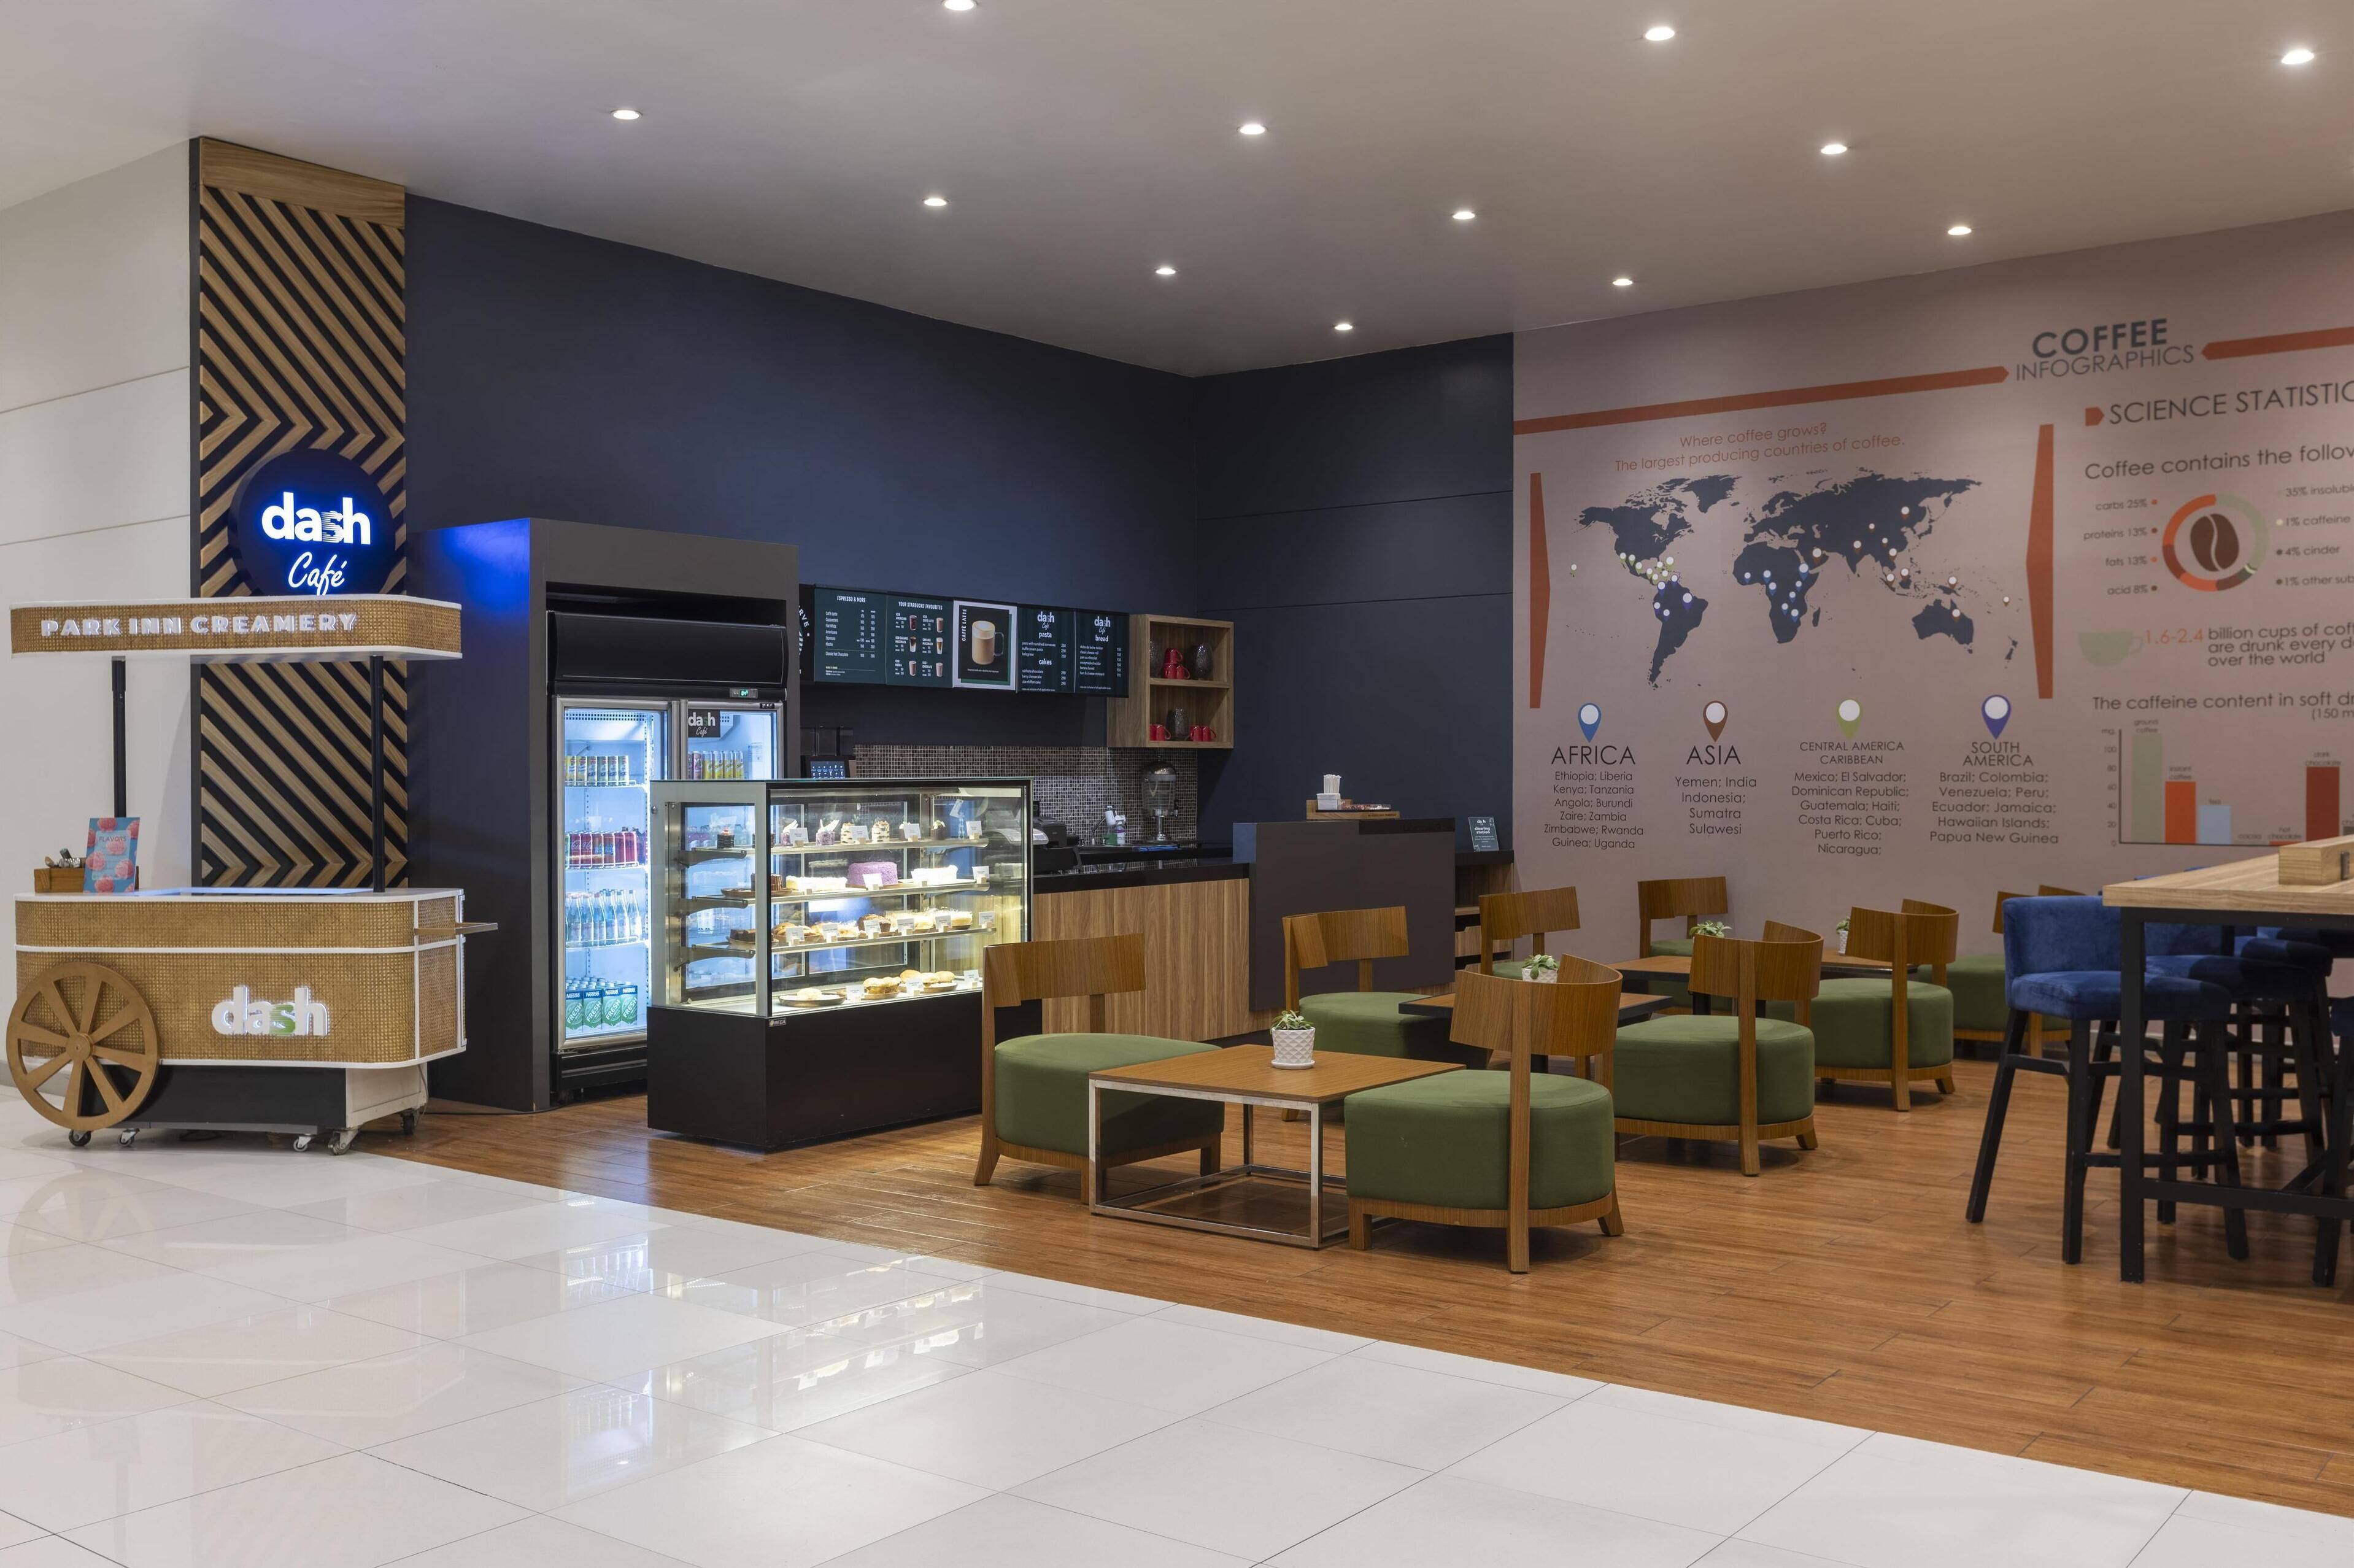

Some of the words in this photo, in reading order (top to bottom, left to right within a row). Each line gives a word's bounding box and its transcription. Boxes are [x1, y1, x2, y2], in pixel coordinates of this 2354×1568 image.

[2032, 319, 2168, 359] COFFEE
[2017, 343, 2194, 380] INFOGRAPHICS
[2110, 393, 2226, 424] SCIENCE
[1680, 435, 1723, 447] Where
[1727, 428, 1775, 442] coffee
[1777, 422, 1827, 441] grows?
[1615, 457, 1637, 471] The
[1640, 450, 1685, 470] largest
[1689, 446, 1760, 468] producing
[1764, 442, 1829, 457] countries
[1833, 438, 1847, 451] of
[1851, 434, 1904, 449] coffee.
[2085, 461, 2155, 479] Coffee
[2161, 452, 2250, 473] contains
[2257, 449, 2292, 465] the
[2285, 487, 2307, 497] 35%
[2310, 484, 2354, 495] insolubl
[2096, 501, 2124, 511] carbs
[2128, 498, 2148, 508] 25%
[261, 492, 371, 545] dash
[2286, 517, 2300, 526] 1%
[2302, 516, 2351, 525] caffeine
[2083, 528, 2124, 541] proteins
[2128, 527, 2148, 536] 13%
[2285, 547, 2301, 556] 4%
[2303, 546, 2340, 555] cinder
[2105, 558, 2124, 566] fats
[2128, 555, 2147, 565] 13%
[288, 552, 347, 595] Café
[2285, 577, 2299, 586] 1%
[2302, 576, 2333, 585] other
[2107, 585, 2131, 595] acid
[2133, 584, 2148, 594] 8%
[1037, 611, 1055, 623] dash
[1094, 616, 1111, 627] dash
[41, 618, 123, 636] PARK
[129, 616, 183, 635] INN
[190, 614, 357, 635] CREAMERY
[2209, 627, 2253, 640] billion
[2258, 627, 2297, 641] cups
[2302, 623, 2318, 636] of
[2323, 622, 2354, 636] cof
[2147, 628, 2204, 644] 1.6-2.4
[2208, 643, 2234, 654] are
[2239, 638, 2285, 652] drunk
[2290, 639, 2336, 652] every
[2208, 656, 2244, 666] over
[2249, 653, 2274, 665] the
[2279, 651, 2325, 664] world
[2093, 697, 2121, 709] The
[2126, 695, 2198, 709] caffeine
[2203, 693, 2273, 708] content
[2279, 693, 2293, 706] in
[2299, 692, 2331, 706] soft
[688, 712, 716, 727] dash
[2312, 708, 2339, 721] (150
[696, 727, 708, 737] Café
[1800, 741, 1848, 751] CENTRAL
[1851, 741, 1904, 751] AMERICA
[1971, 741, 2020, 754] SOUTH
[1551, 746, 1635, 765] AFRICA
[1686, 745, 1741, 765] ASIA
[1820, 755, 1883, 764] CARIBBEAN
[1962, 754, 2033, 767] AMERICA
[1556, 771, 1596, 782] Ethiopia;
[1600, 771, 1632, 781] Liberia
[1675, 777, 1721, 788] Yemen;
[1726, 776, 1756, 787] India
[1794, 771, 1837, 782] Mexico;
[1842, 771, 1849, 781] El
[1853, 771, 1906, 782] Salvador;
[1979, 771, 2048, 782] Colombia;
[1554, 785, 1586, 795] Kenya;
[1589, 785, 1634, 794] Tanzania
[1792, 786, 1852, 796] Dominican
[1856, 786, 1908, 798] Republic;
[1939, 787, 2011, 798] Venezuela;
[2016, 787, 2048, 798] Peru;
[1554, 798, 1592, 809] Angola;
[1597, 798, 1632, 808] Burundi
[1682, 792, 1745, 803] Indonesia;
[1800, 800, 1869, 811] Guatemala;
[1872, 801, 1899, 811] Haiti;
[1932, 801, 1989, 813] Ecuador;
[1994, 802, 2056, 813] Jamaica;
[1560, 811, 1586, 821] Zaire;
[1589, 811, 1626, 821] Zambia
[1689, 808, 1740, 819] Sumatra
[1799, 814, 1831, 825] Costa
[1835, 815, 1862, 825] Rica;
[1866, 815, 1901, 827] Cuba;
[1939, 817, 1998, 827] Hawaiian
[2002, 817, 2050, 828] Islands;
[1544, 824, 1598, 835] Zimbabwe;
[1602, 825, 1643, 835] Rwanda
[1689, 823, 1741, 835] Sulawesi
[1815, 829, 1850, 840] Puerto
[1854, 830, 1881, 841] Rico;
[1930, 831, 1971, 843] Papua
[1976, 832, 2005, 843] New
[2009, 832, 2058, 844] Guinea
[1595, 839, 1635, 850] Uganda
[1818, 843, 1881, 856] Nicaragua;
[211, 985, 330, 1037] dash
[566, 1002, 583, 1024] FRESH
[586, 1001, 602, 1022] FRESH
[605, 999, 621, 1020] FRESH
[623, 997, 638, 1018] FRESH
